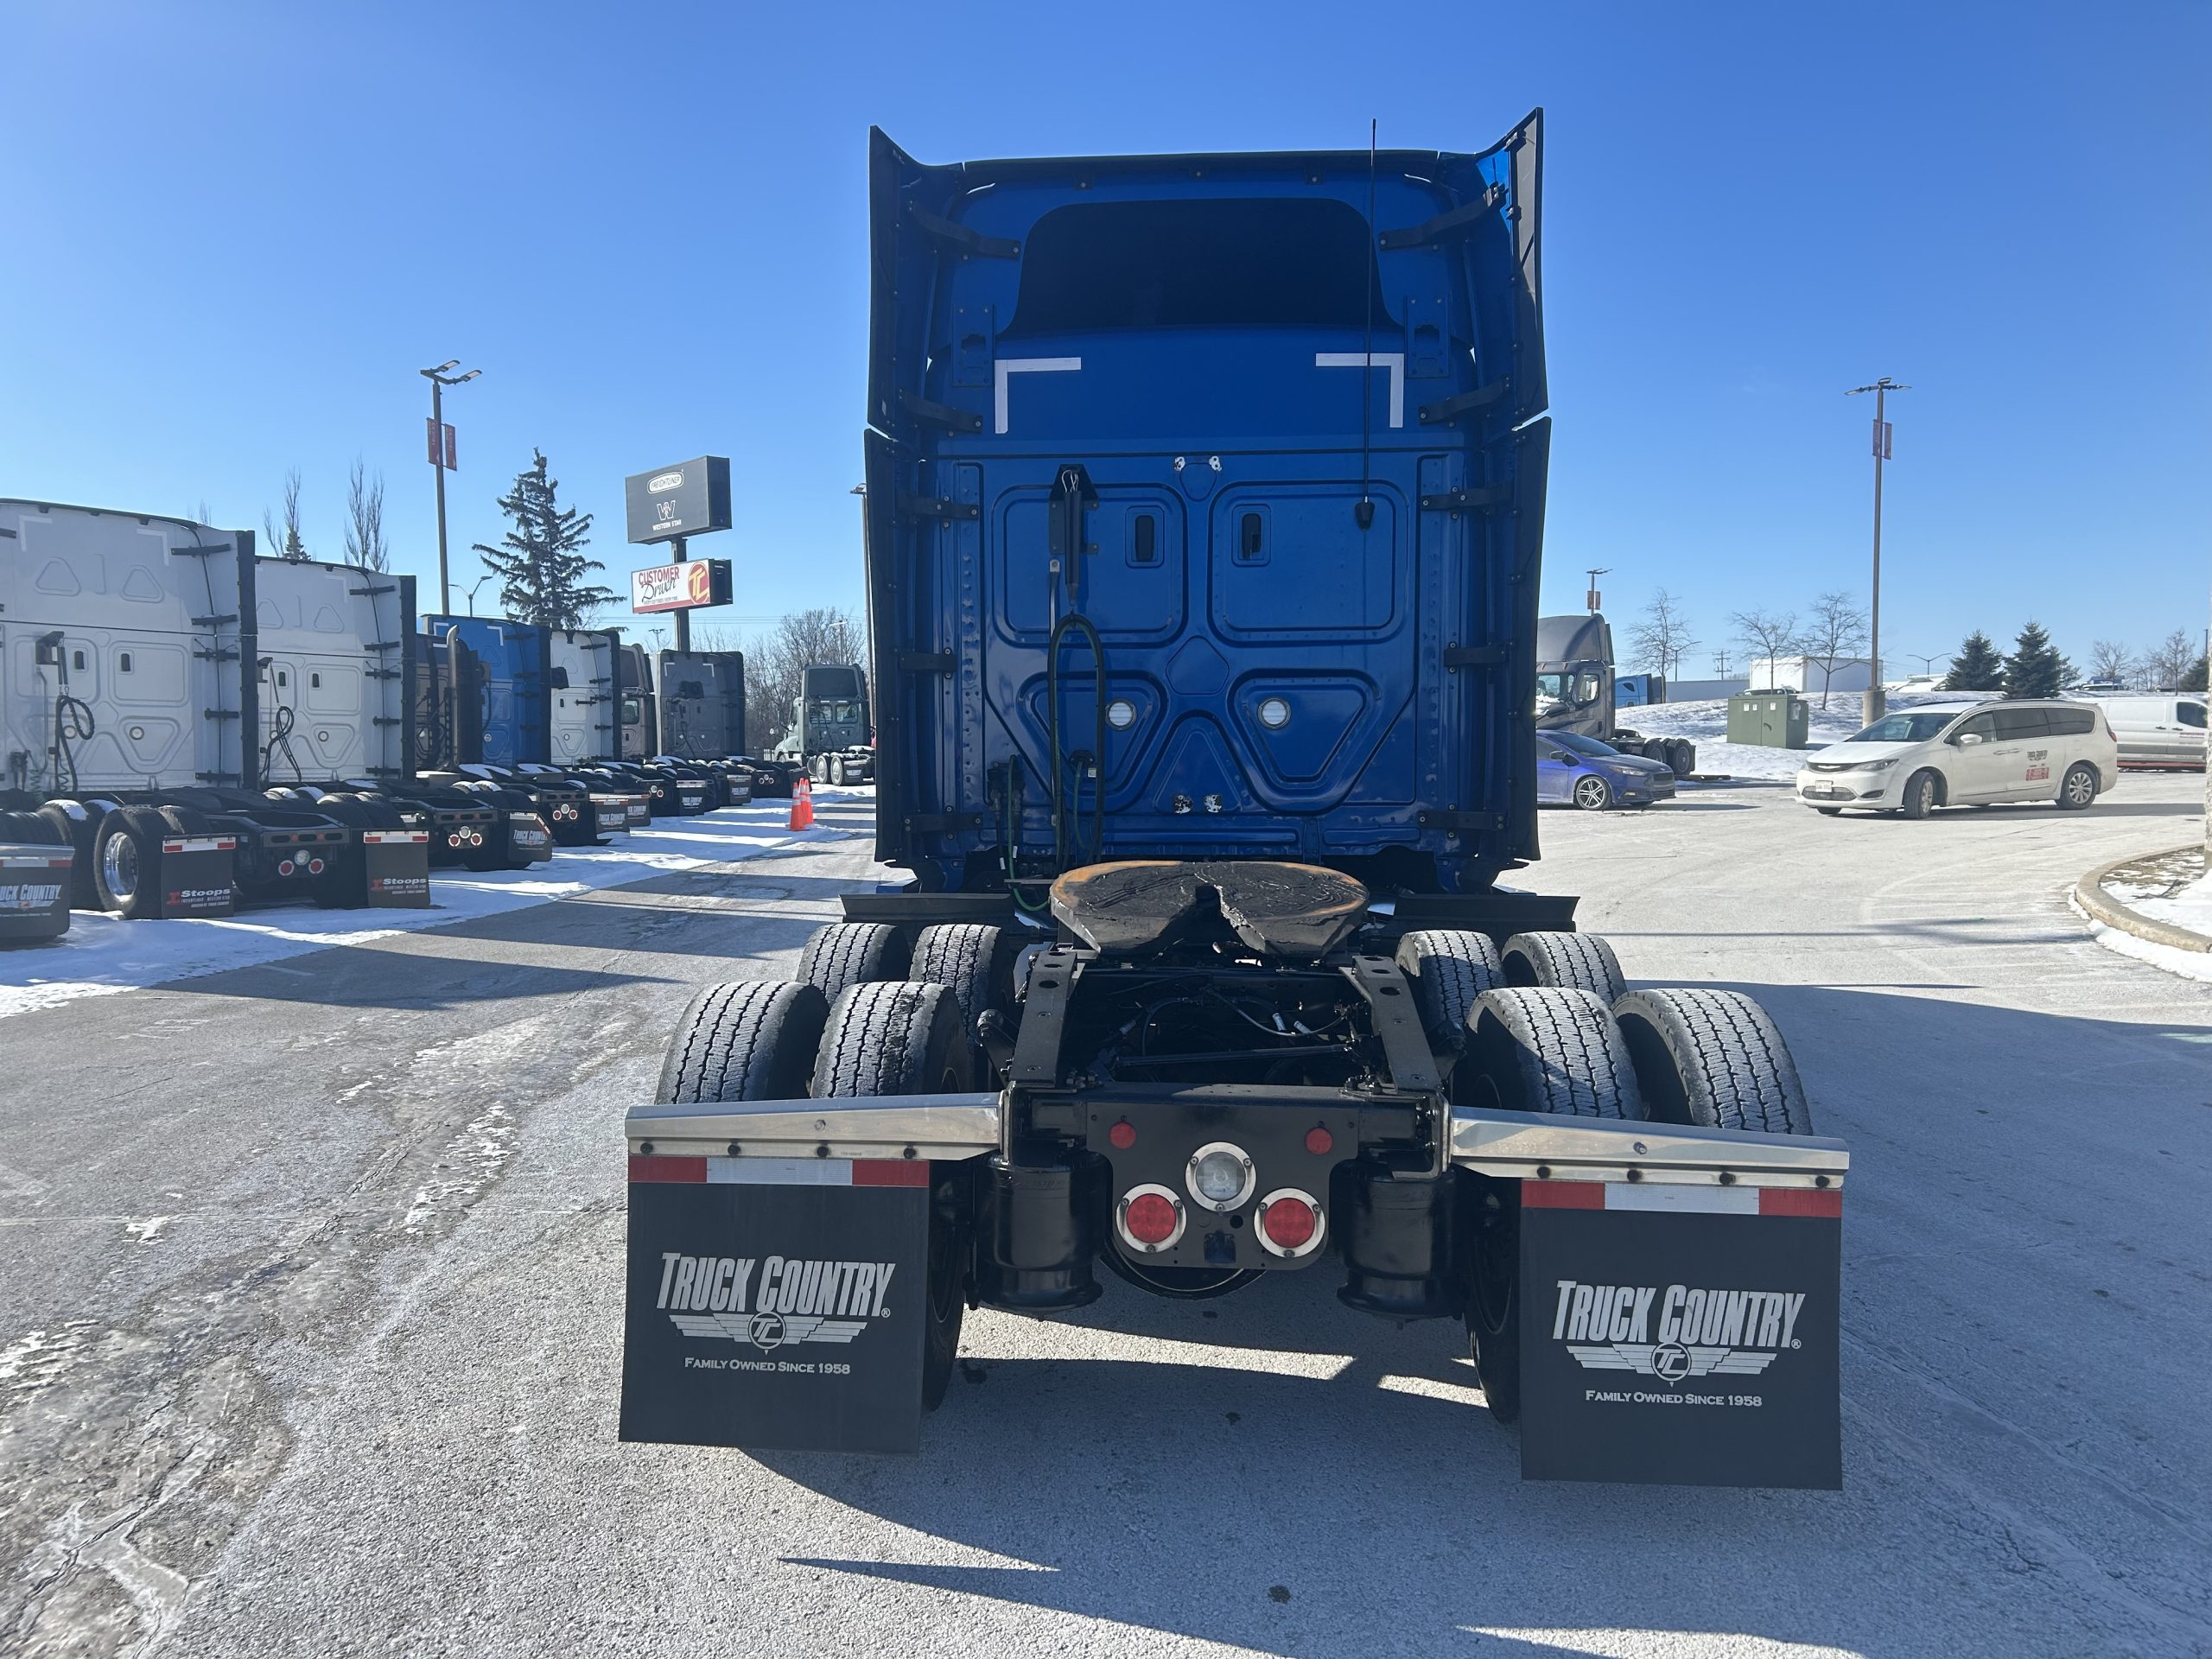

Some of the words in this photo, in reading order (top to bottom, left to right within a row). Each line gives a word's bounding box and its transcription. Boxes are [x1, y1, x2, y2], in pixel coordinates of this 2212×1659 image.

[639, 566, 680, 585] CUSTOMER
[641, 578, 677, 602] Driven
[0, 885, 19, 900] UCK
[20, 884, 62, 899] COUNTRY
[181, 888, 231, 898] Stoops
[657, 1252, 756, 1312] TRUCK
[1553, 1280, 1656, 1343] TRUCK
[818, 1363, 850, 1375] 1958
[1727, 1395, 1763, 1407] 1958
